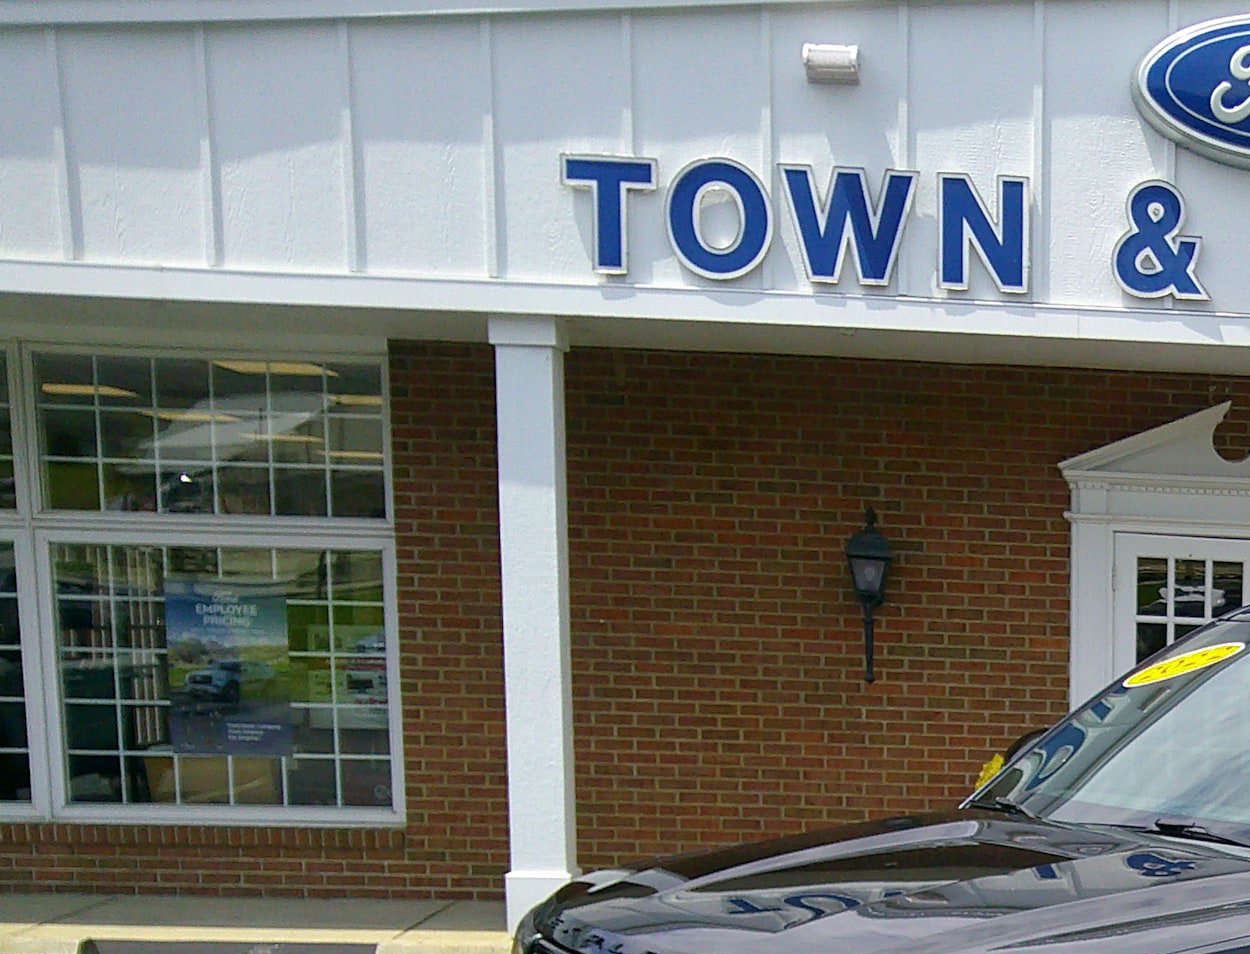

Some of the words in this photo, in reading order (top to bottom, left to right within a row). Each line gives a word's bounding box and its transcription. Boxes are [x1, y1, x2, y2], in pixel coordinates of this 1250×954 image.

[561, 152, 1028, 294] TOWN
[1112, 179, 1210, 301] &
[195, 602, 258, 617] EMPLOYEE
